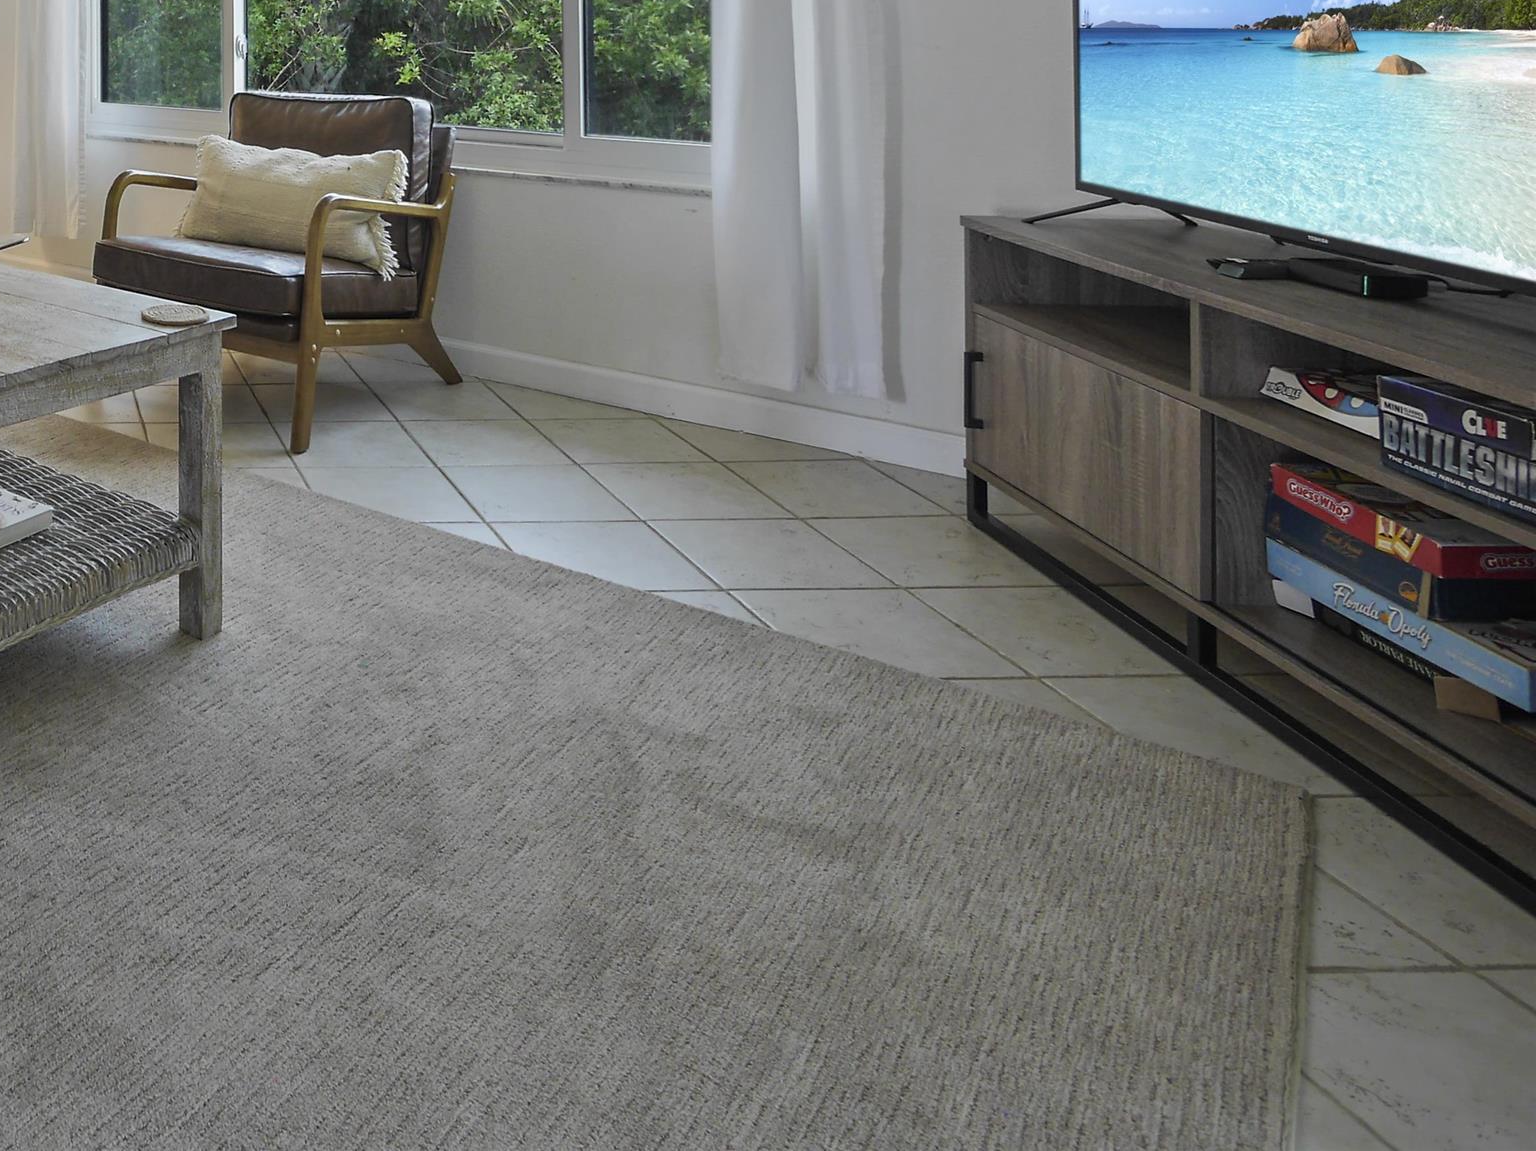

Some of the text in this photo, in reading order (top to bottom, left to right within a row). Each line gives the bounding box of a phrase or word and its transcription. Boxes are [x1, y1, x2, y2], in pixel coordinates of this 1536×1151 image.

[1383, 401, 1403, 415] MINI
[1462, 409, 1507, 440] CLUE
[1387, 454, 1403, 465] THE
[1404, 460, 1438, 477] CLASSIC
[1438, 473, 1467, 489] NAVAL
[1468, 485, 1509, 503] COMBAT
[1319, 494, 1352, 520] Who?
[1333, 582, 1380, 620] Florida
[1388, 605, 1432, 649] Opoly
